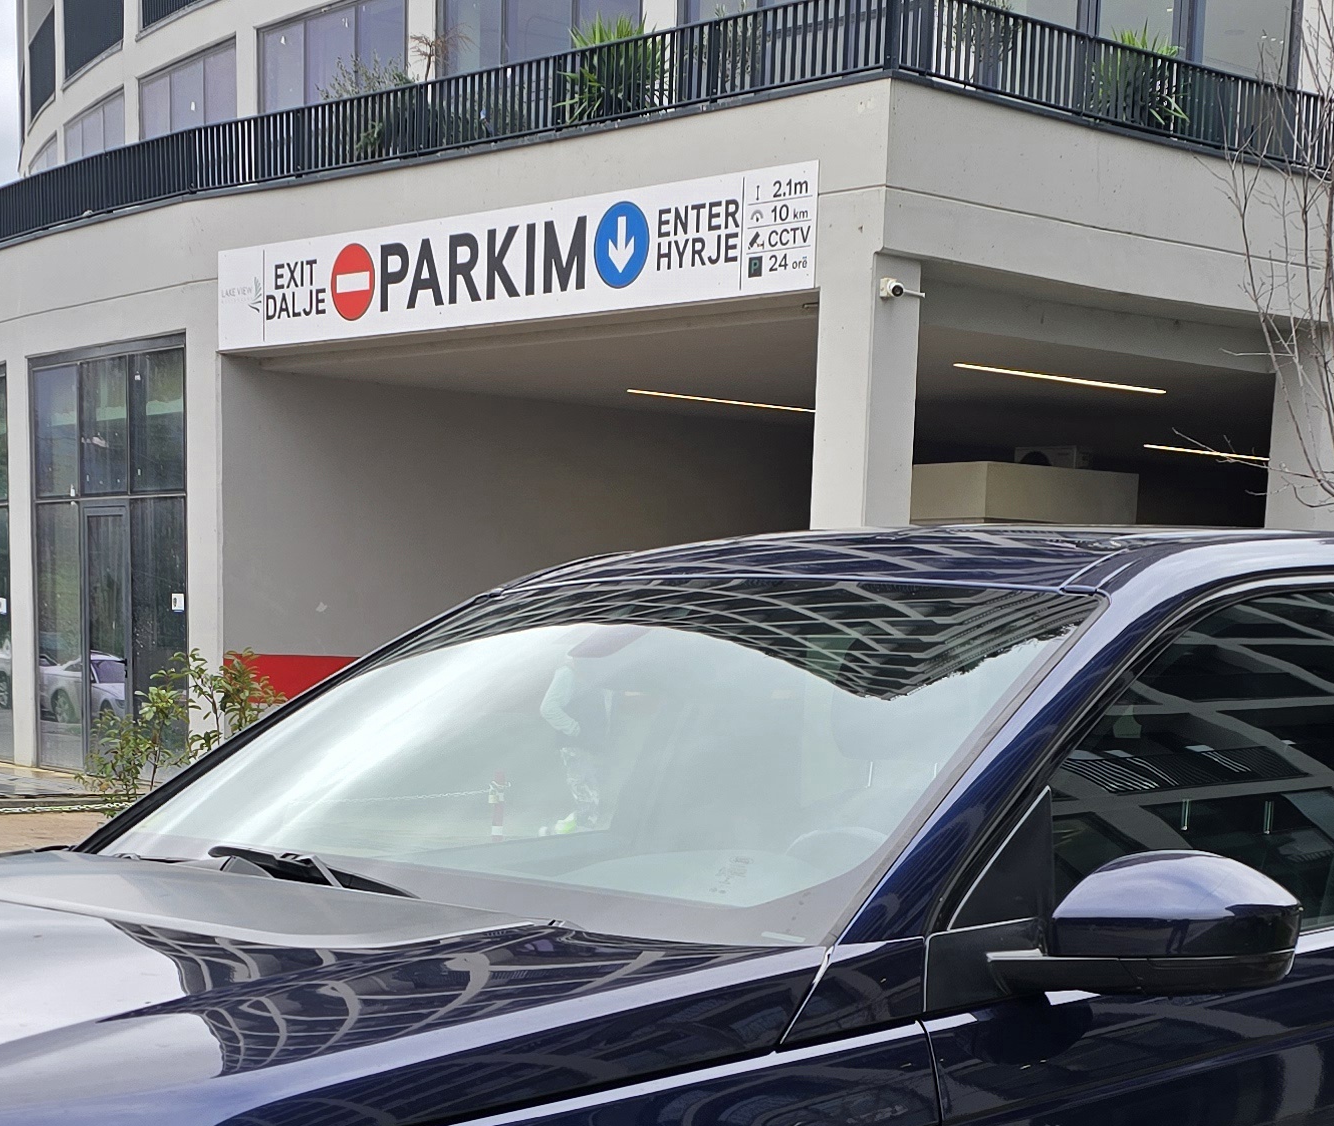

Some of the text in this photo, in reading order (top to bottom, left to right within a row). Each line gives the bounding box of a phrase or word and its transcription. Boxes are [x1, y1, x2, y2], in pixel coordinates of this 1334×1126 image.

[772, 179, 808, 198] 2.1m
[658, 199, 739, 238] ENTER
[771, 204, 809, 222] 10 km
[657, 232, 739, 271] HYRJE
[768, 225, 811, 248] CCTV
[274, 259, 317, 290] EXIT
[380, 215, 587, 313] PARKIM
[768, 253, 788, 272] 24
[792, 256, 808, 270] orë
[266, 288, 326, 321] DALJE
